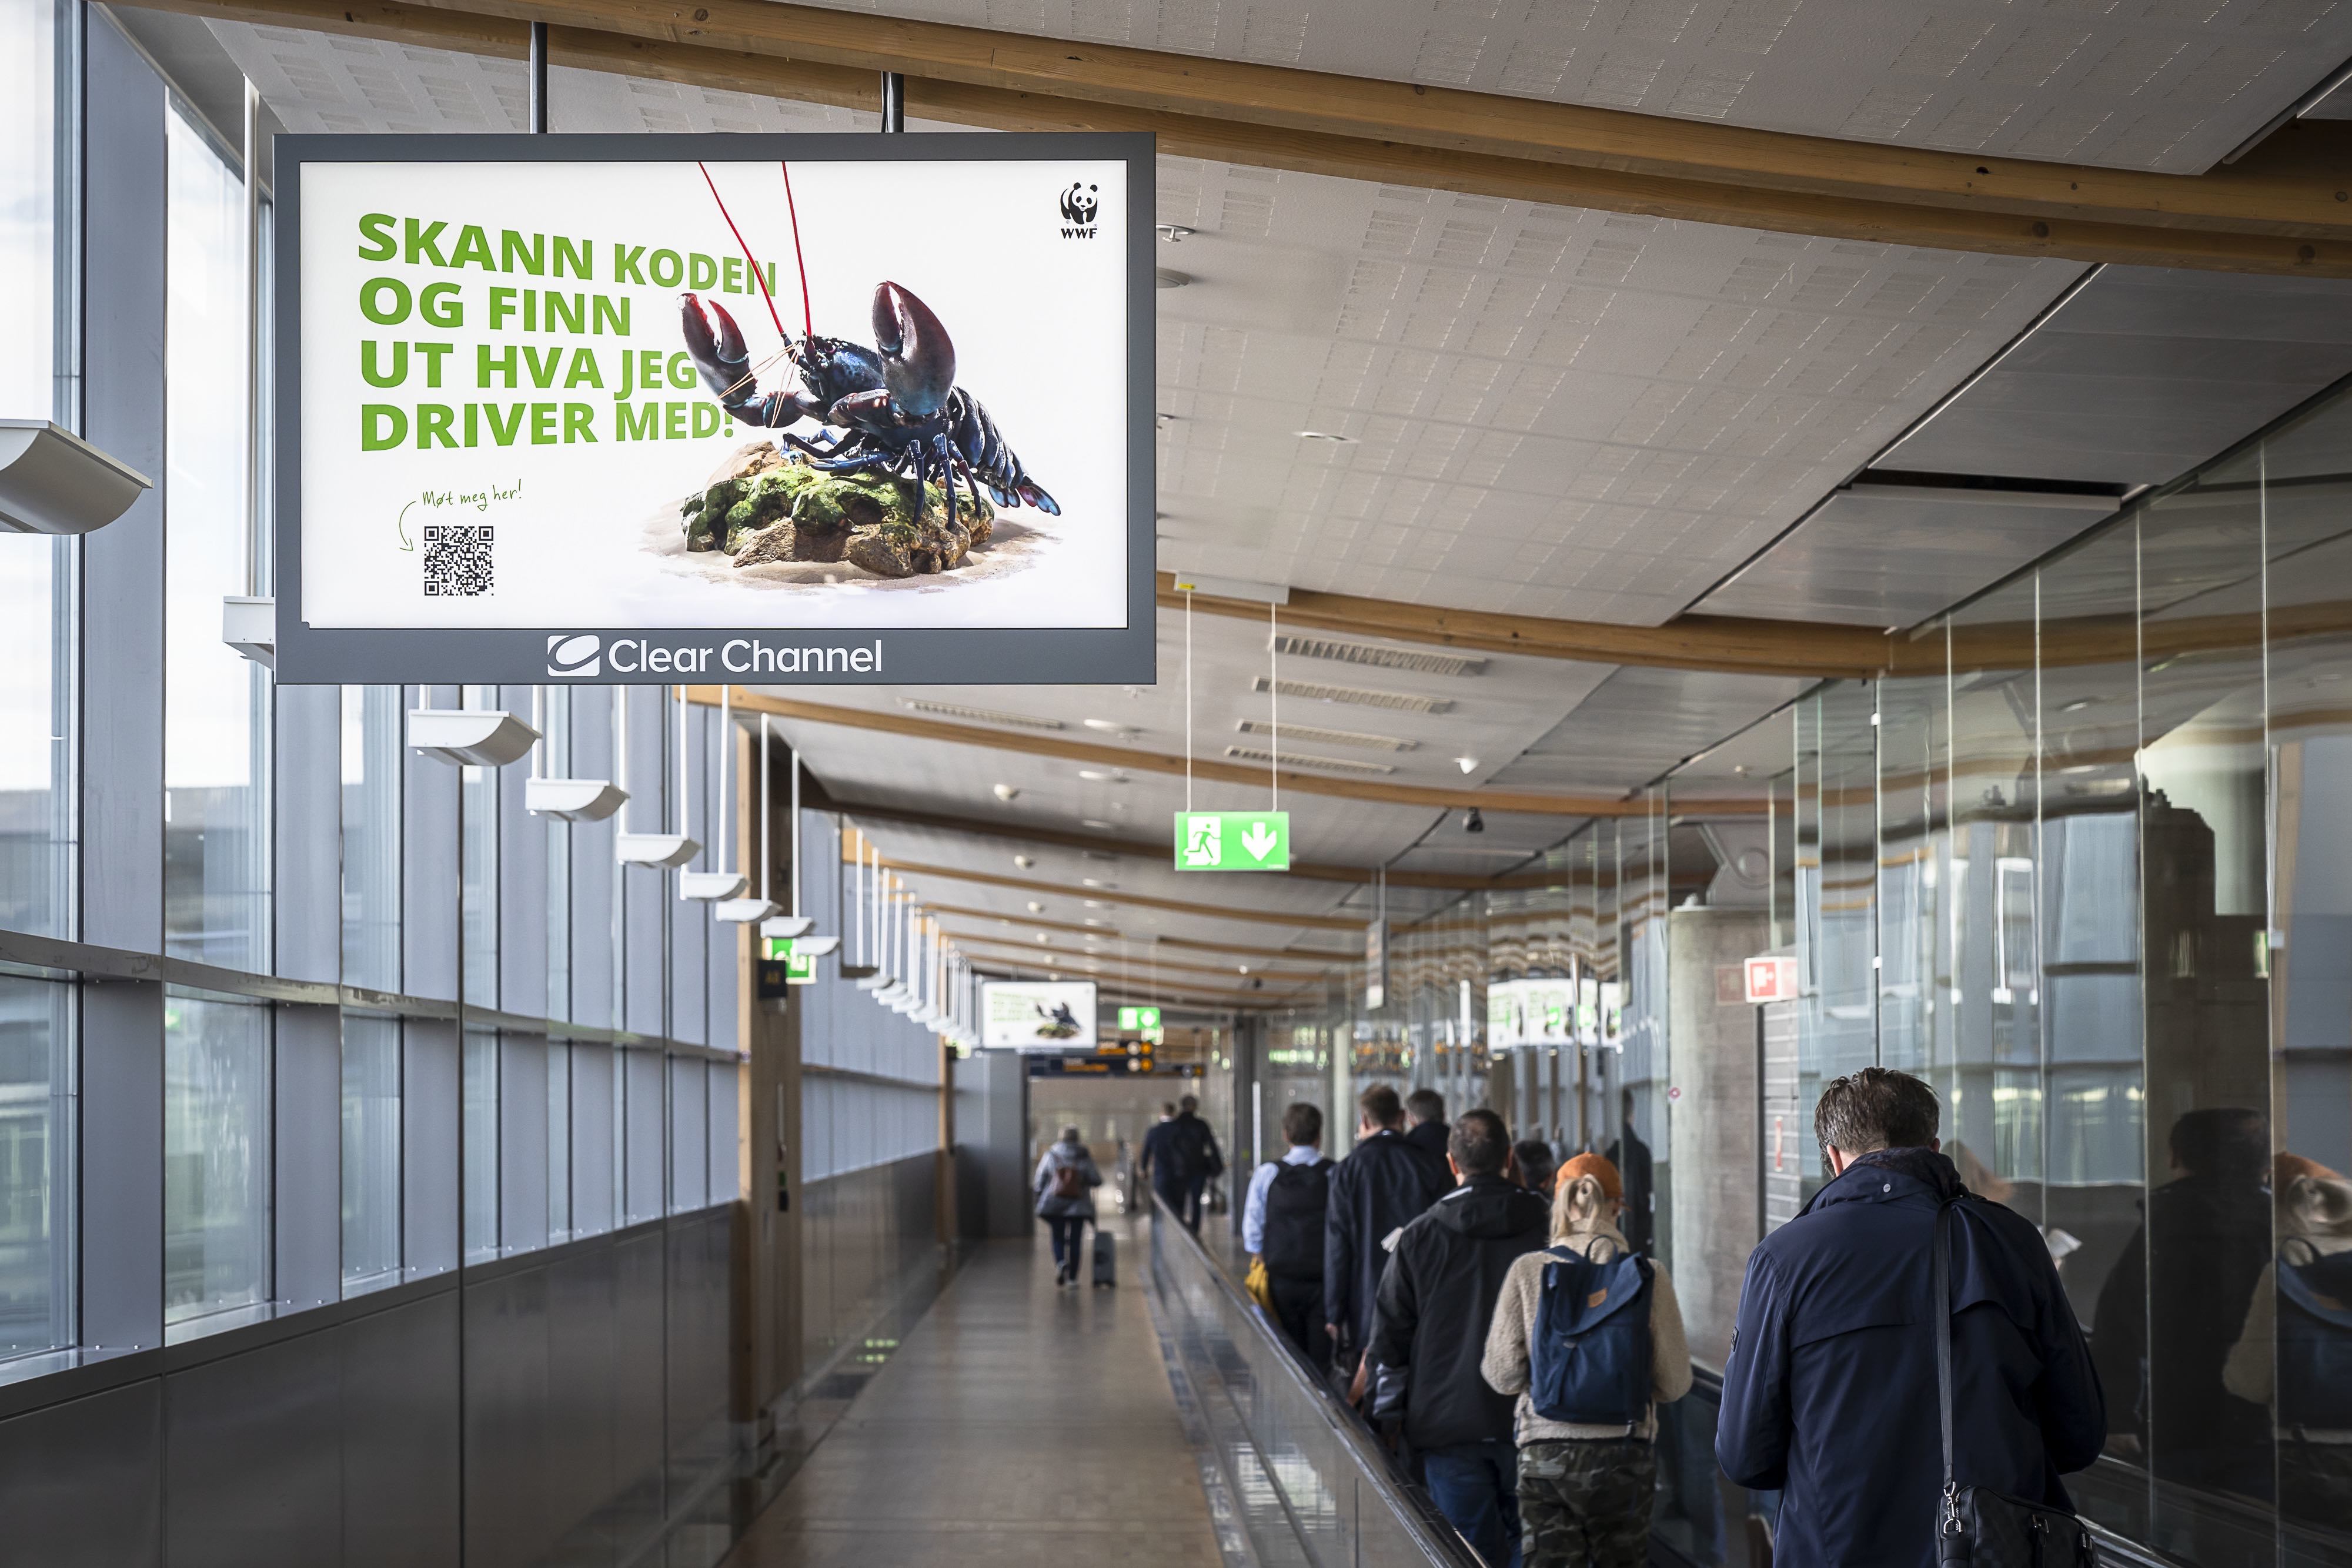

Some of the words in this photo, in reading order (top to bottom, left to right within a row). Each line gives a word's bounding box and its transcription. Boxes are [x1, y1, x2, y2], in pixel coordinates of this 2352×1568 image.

[359, 213, 593, 280] SKANN
[614, 243, 776, 297] KODEN
[1060, 228, 1098, 239] WWF
[359, 277, 463, 328] OG
[489, 286, 630, 336] FINN
[361, 340, 453, 388] UT
[477, 345, 603, 389] HVA
[614, 350, 697, 400] JEG
[362, 403, 598, 452] DRIVER
[616, 402, 733, 442] MED!
[423, 490, 453, 509] Møt
[460, 493, 489, 511] meg
[492, 479, 522, 501] her!
[609, 639, 713, 673] Clear
[721, 639, 882, 673] Channel
